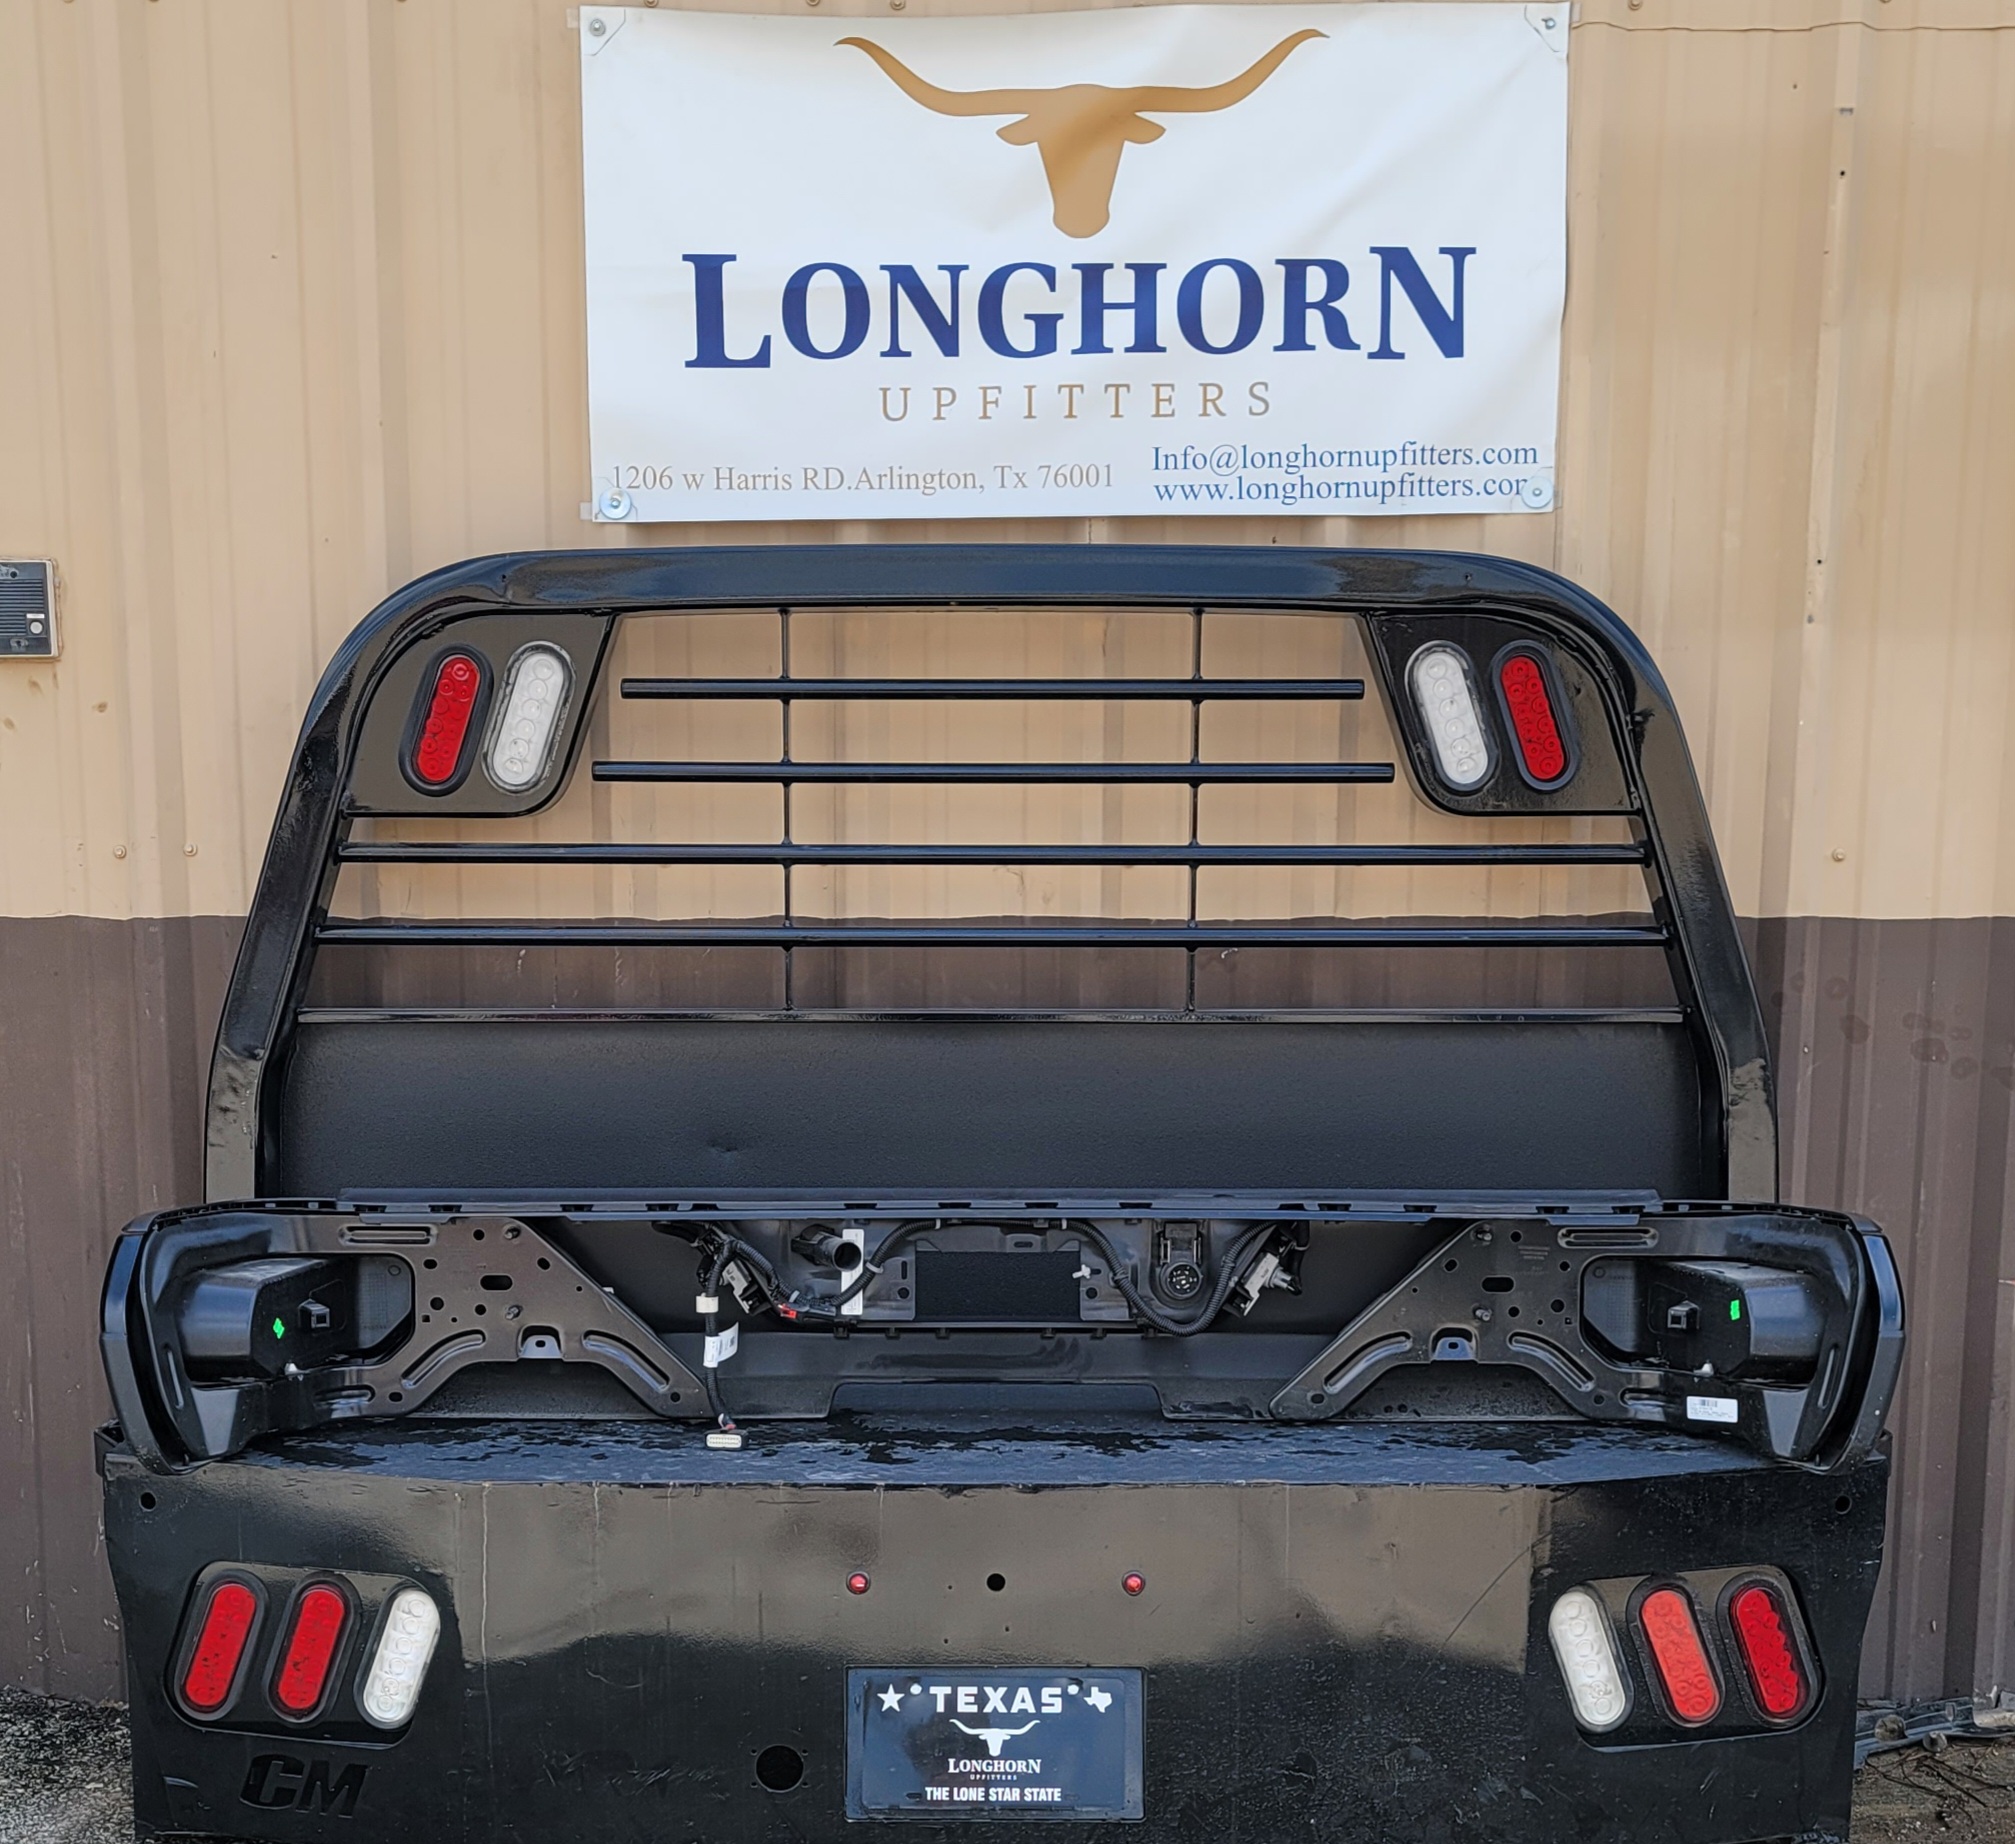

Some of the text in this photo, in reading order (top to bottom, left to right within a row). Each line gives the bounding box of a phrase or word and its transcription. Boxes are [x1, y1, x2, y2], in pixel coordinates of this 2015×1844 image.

[682, 246, 1477, 368] LONGHORN
[879, 381, 1271, 422] UPFITTERS
[1152, 441, 1539, 476] Info@longhornupfitters.com
[613, 463, 1114, 497] 1206 w Harris RD.Arlington, Tx 76001
[929, 1686, 1063, 1713] TEXAS
[948, 1758, 1042, 1774] LONGHORN
[240, 1754, 368, 1819] CM
[925, 1786, 1062, 1802] THE LONE STAR STATE
